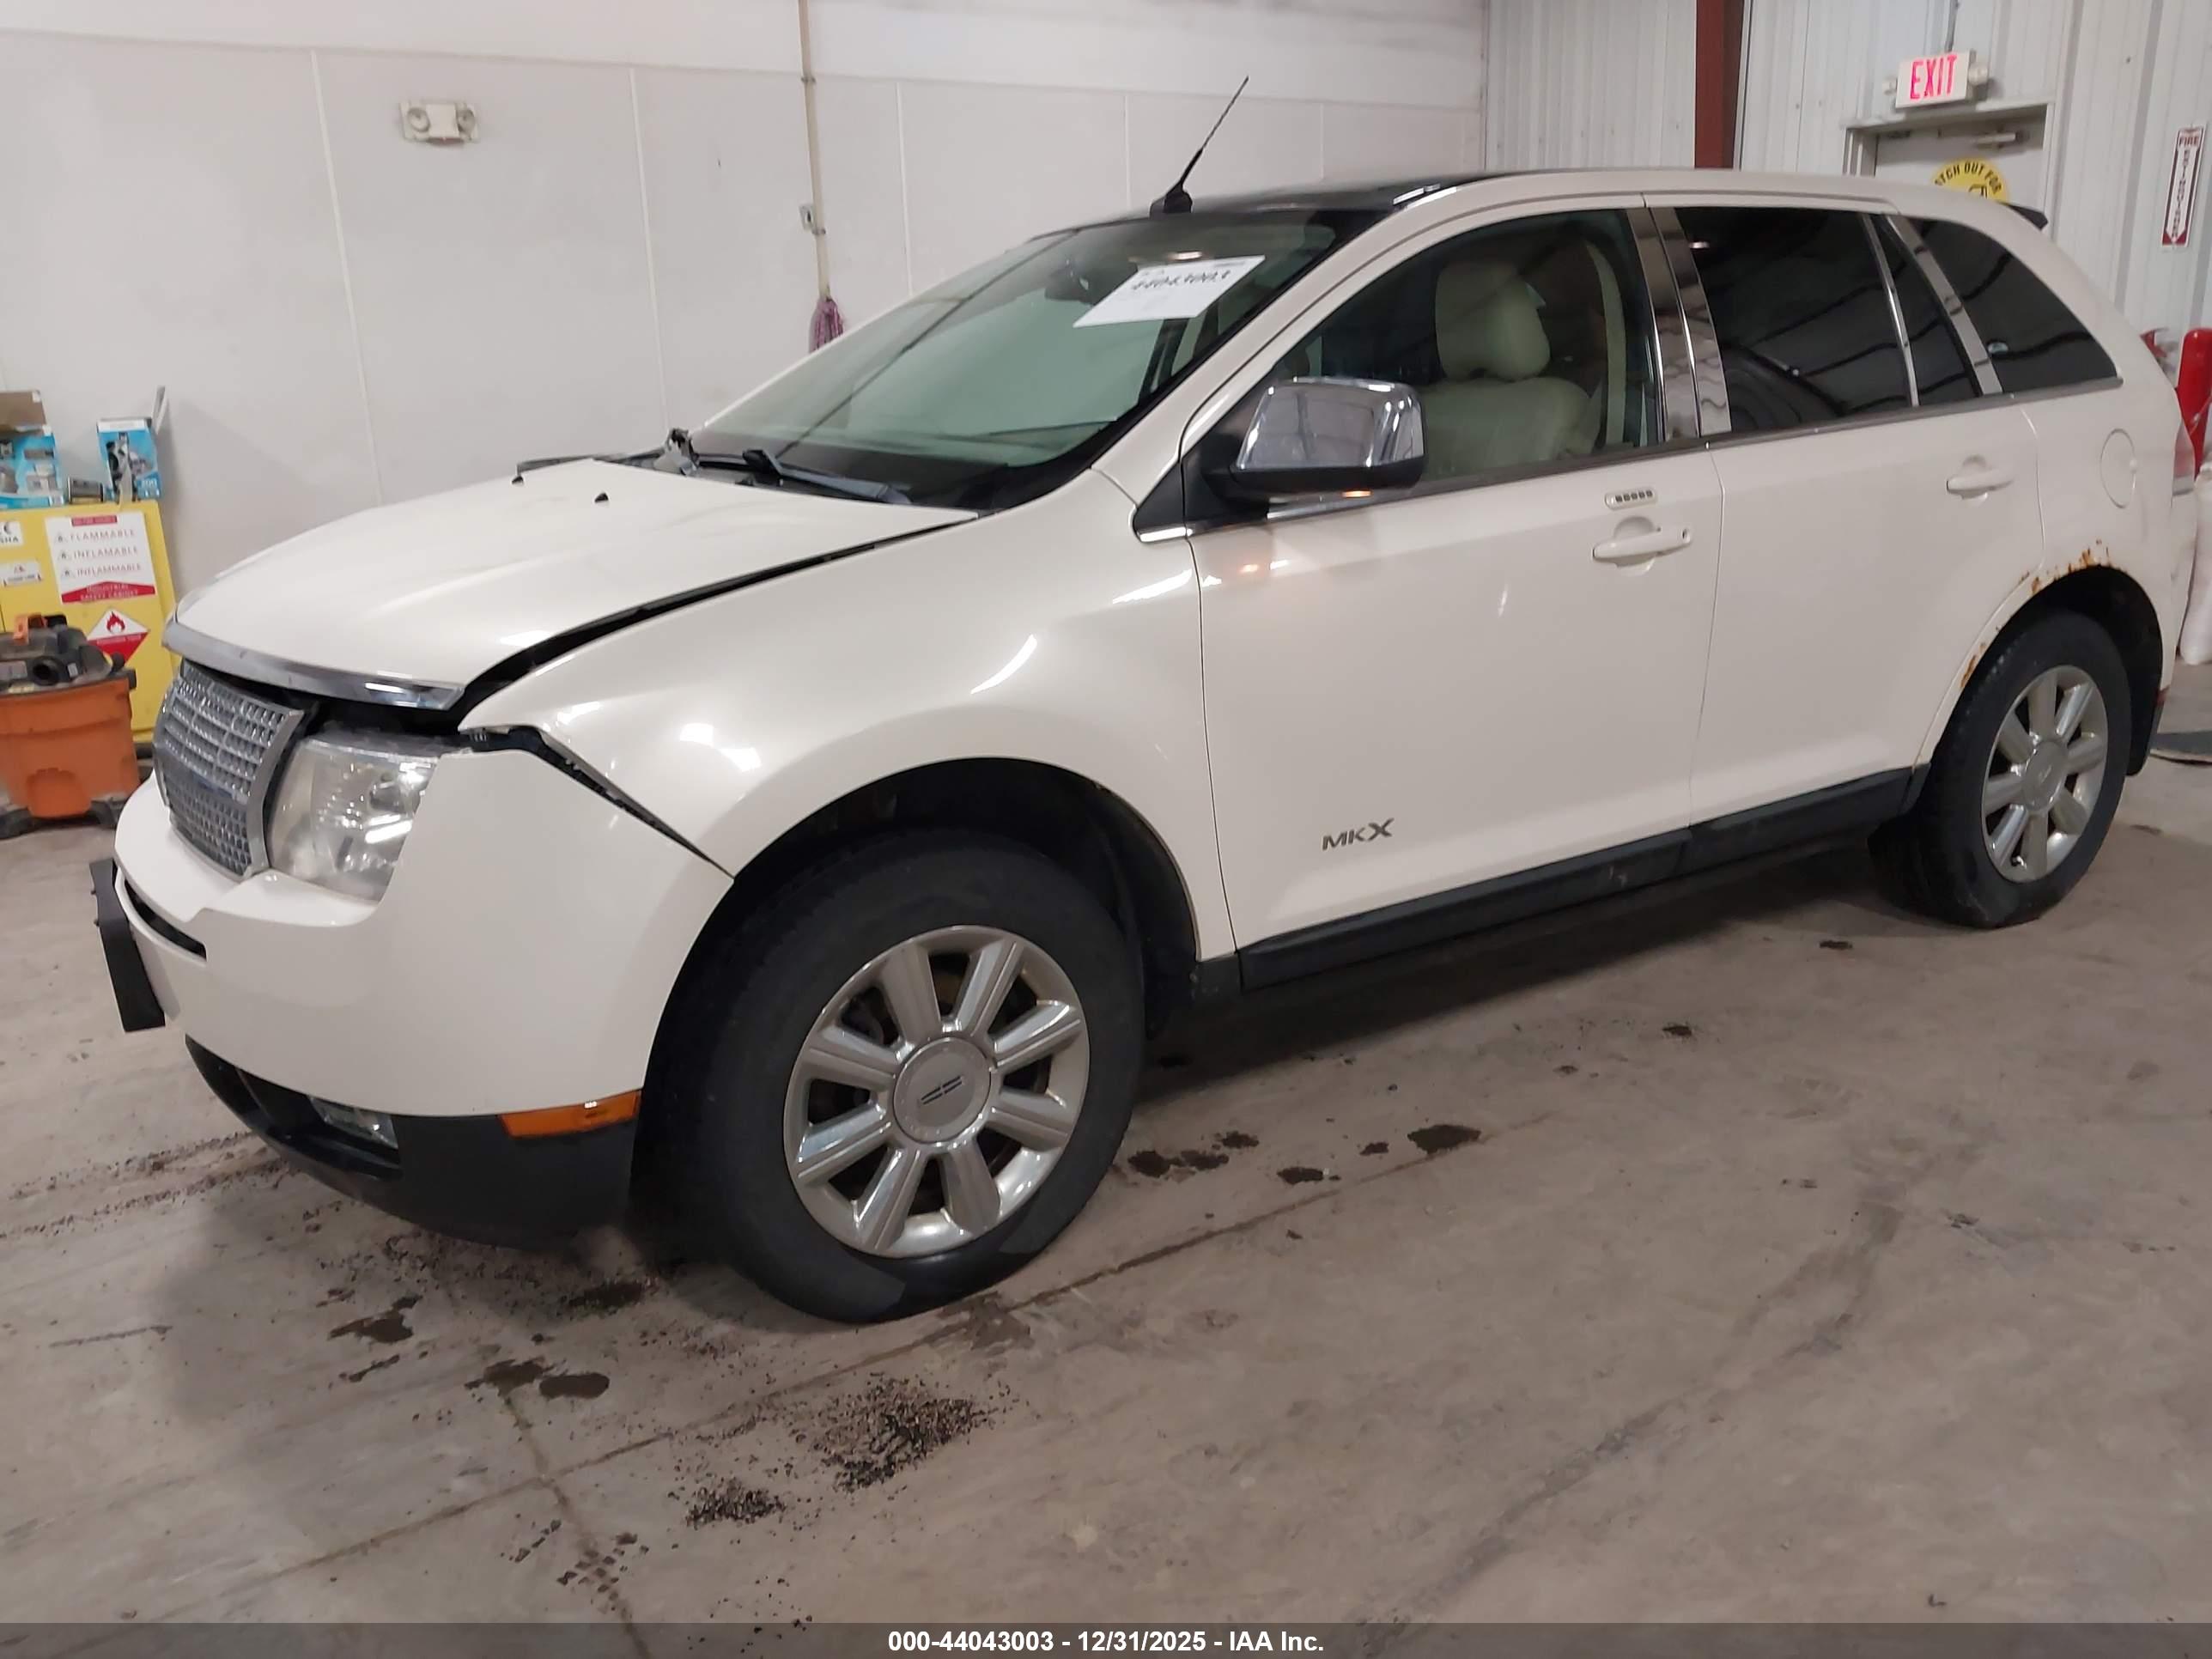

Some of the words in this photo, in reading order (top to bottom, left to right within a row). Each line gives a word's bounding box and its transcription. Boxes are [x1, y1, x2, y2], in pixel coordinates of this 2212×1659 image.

[1910, 54, 1957, 100] EXIT
[2179, 136, 2200, 146] FIRE
[1964, 161, 1984, 176] OUT
[1984, 169, 2002, 195] FOR
[70, 528, 135, 541] FLAMMABLE
[74, 545, 138, 560] INFLAMABLE
[76, 563, 142, 577] INFLAMMABLE
[1322, 817, 1395, 851] MKX
